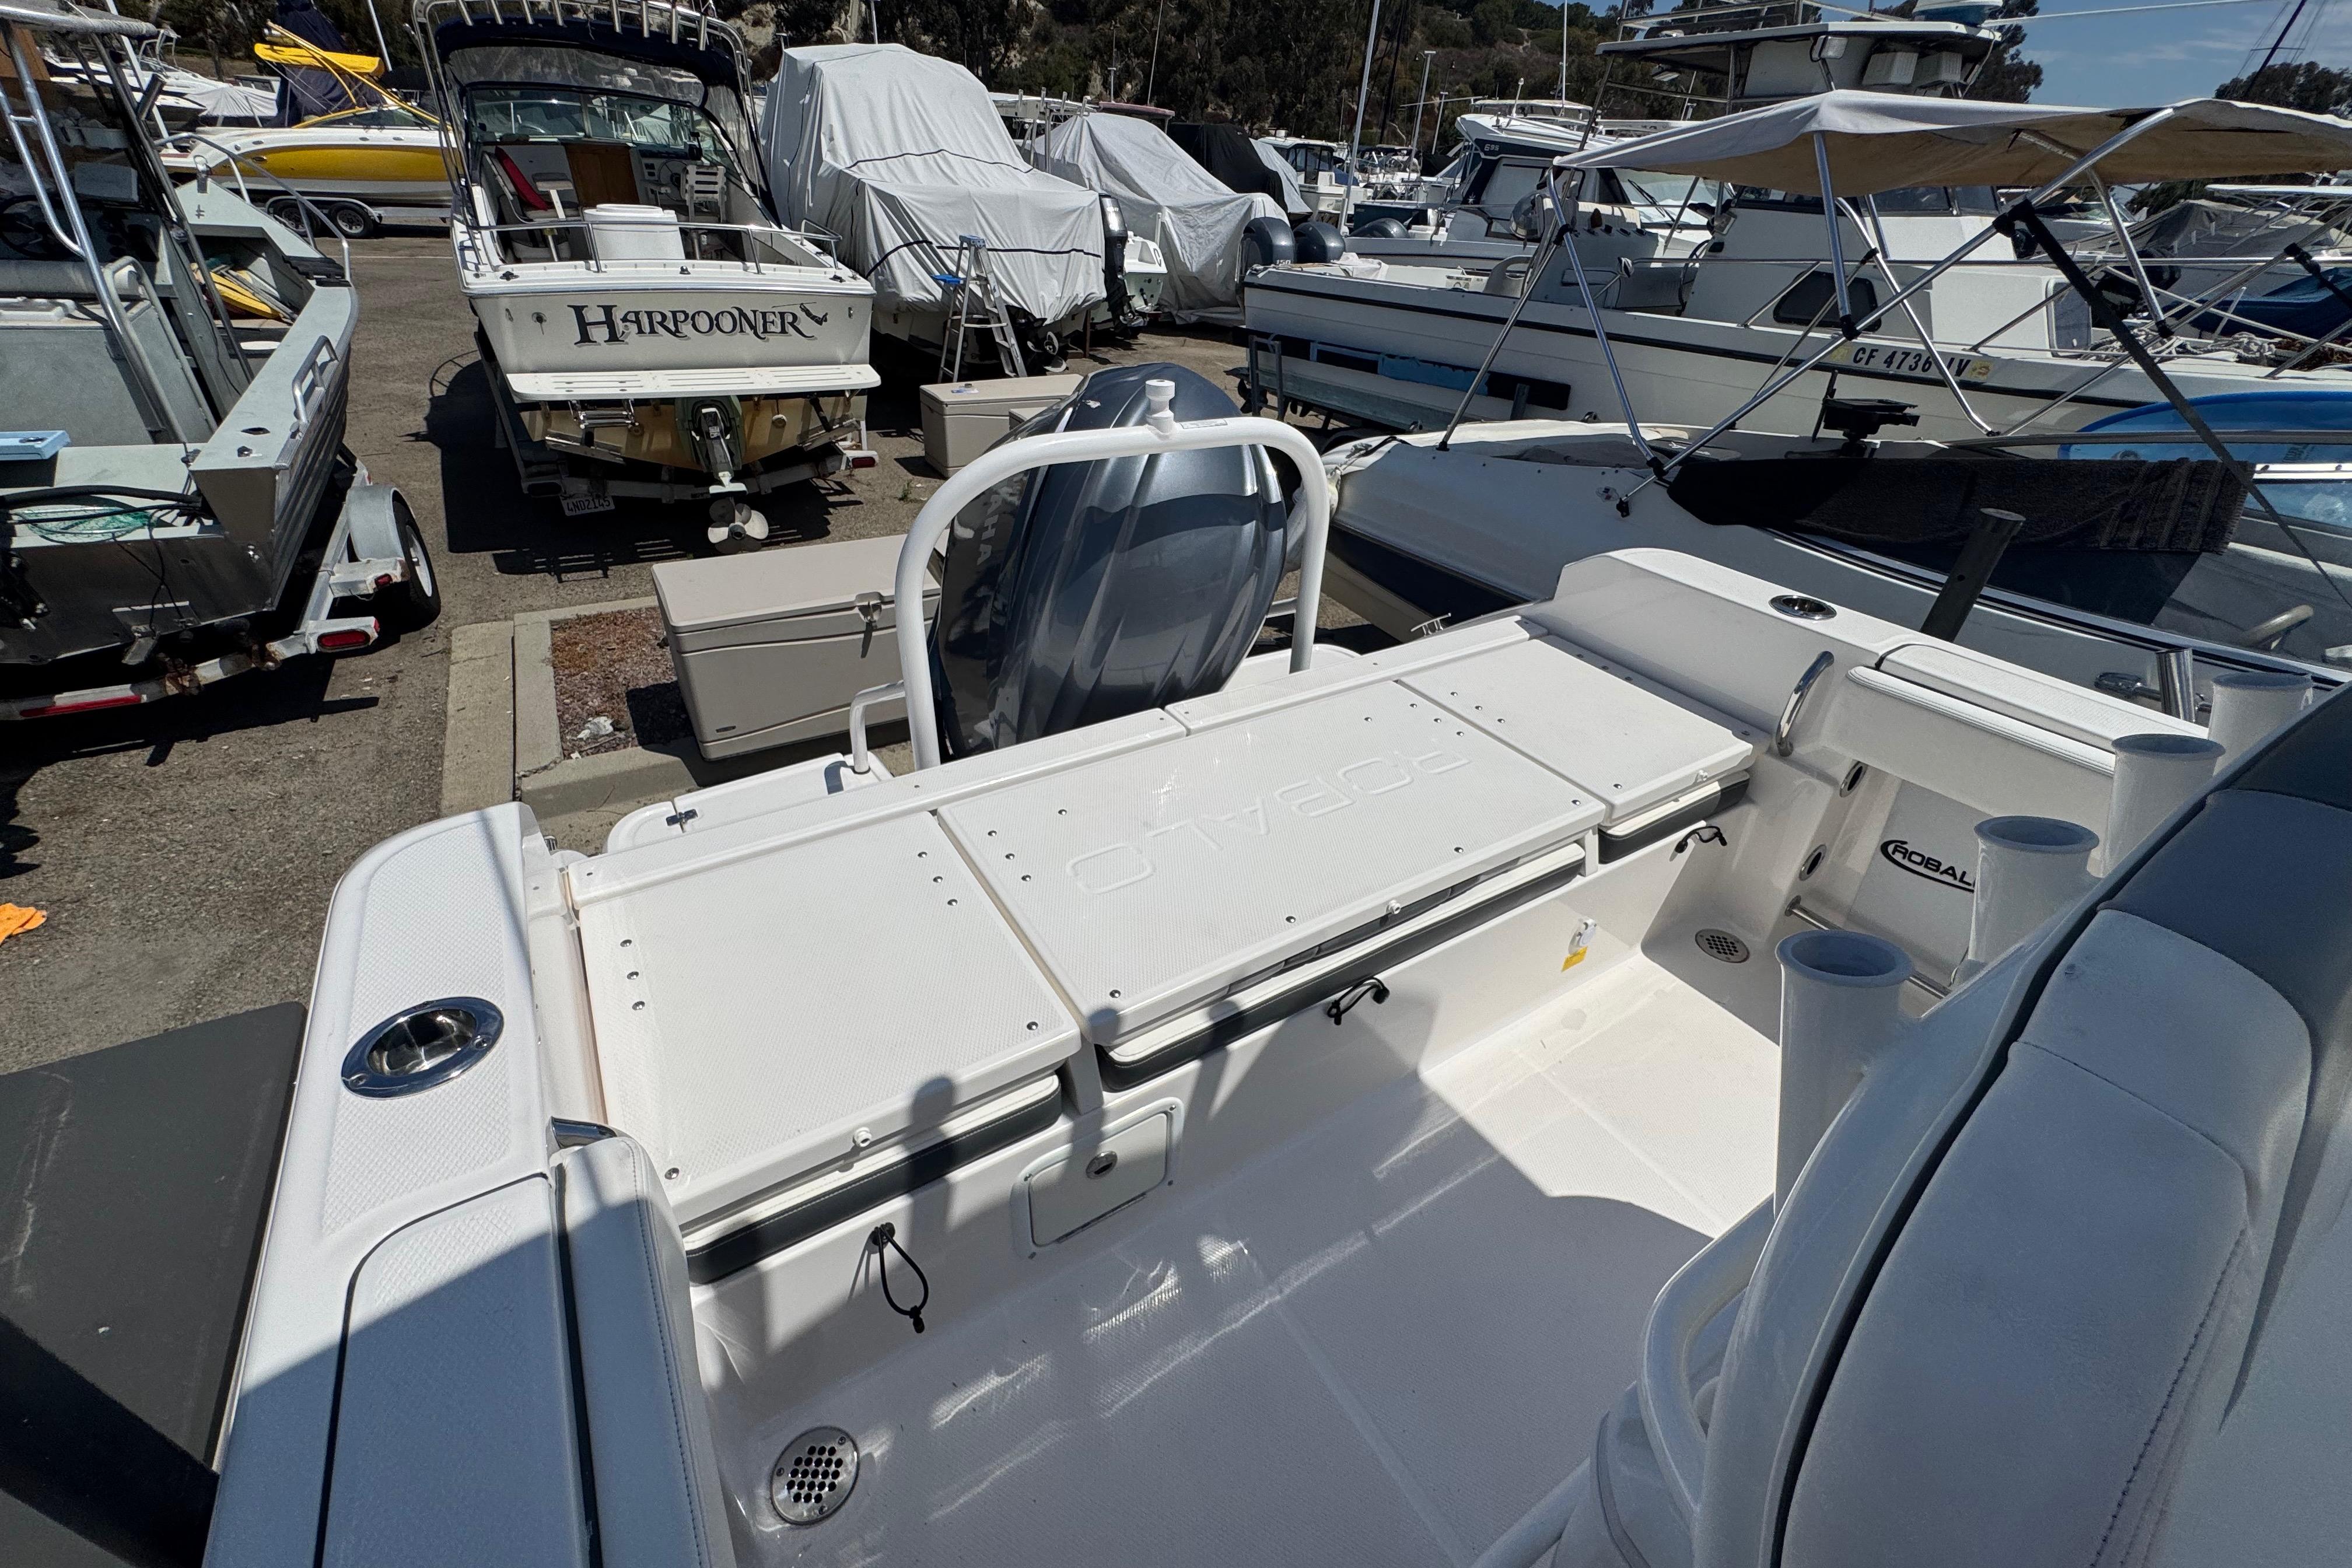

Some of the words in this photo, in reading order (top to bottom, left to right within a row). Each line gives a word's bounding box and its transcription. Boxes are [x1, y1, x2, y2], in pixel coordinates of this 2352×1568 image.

[567, 304, 816, 346] HARPOONER
[1852, 346, 1878, 366] CF
[1883, 350, 1932, 373] 4736
[1065, 750, 1472, 895] ROBALO
[1891, 844, 1976, 889] ROBAL
